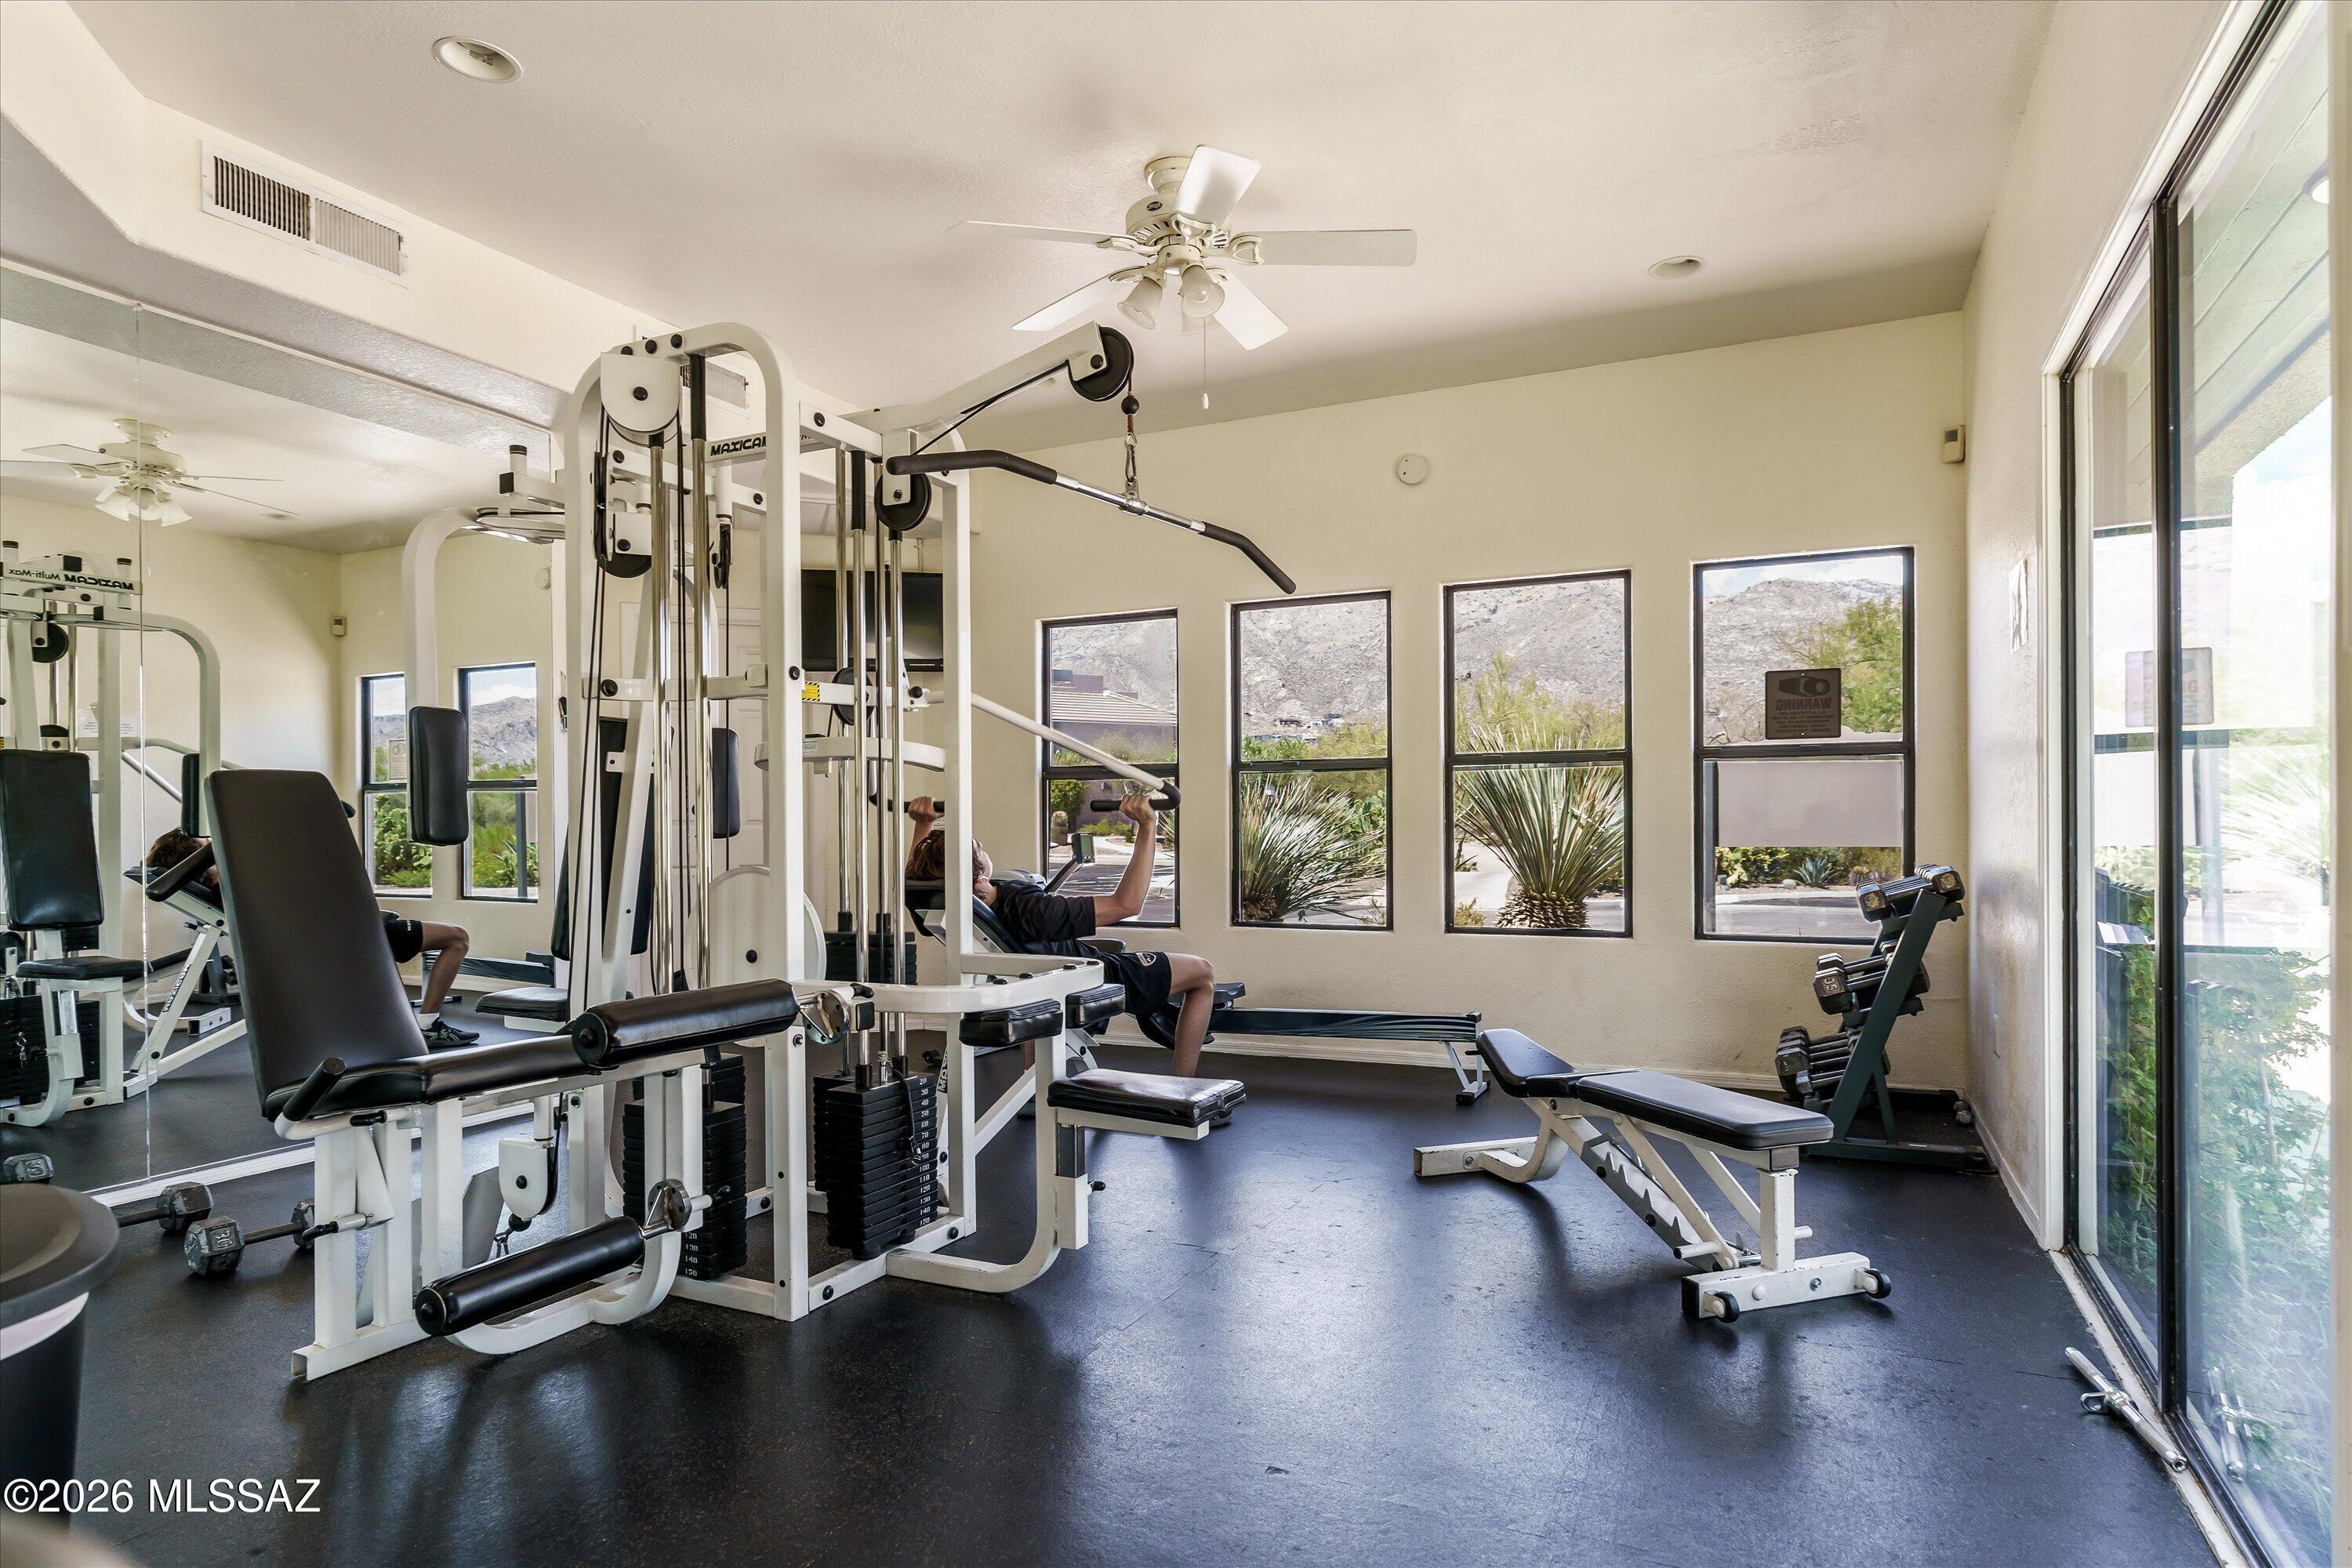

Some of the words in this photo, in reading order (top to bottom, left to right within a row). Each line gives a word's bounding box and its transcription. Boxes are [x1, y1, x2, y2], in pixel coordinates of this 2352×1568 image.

[920, 1163, 930, 1172] 100
[920, 1174, 930, 1183] 110
[920, 1184, 931, 1193] 120
[920, 1196, 931, 1204] 130
[920, 1206, 931, 1215] 140
[920, 1217, 930, 1226] 150
[214, 1230, 233, 1248] 30
[685, 1255, 698, 1264] 140
[685, 1268, 698, 1276] 150
